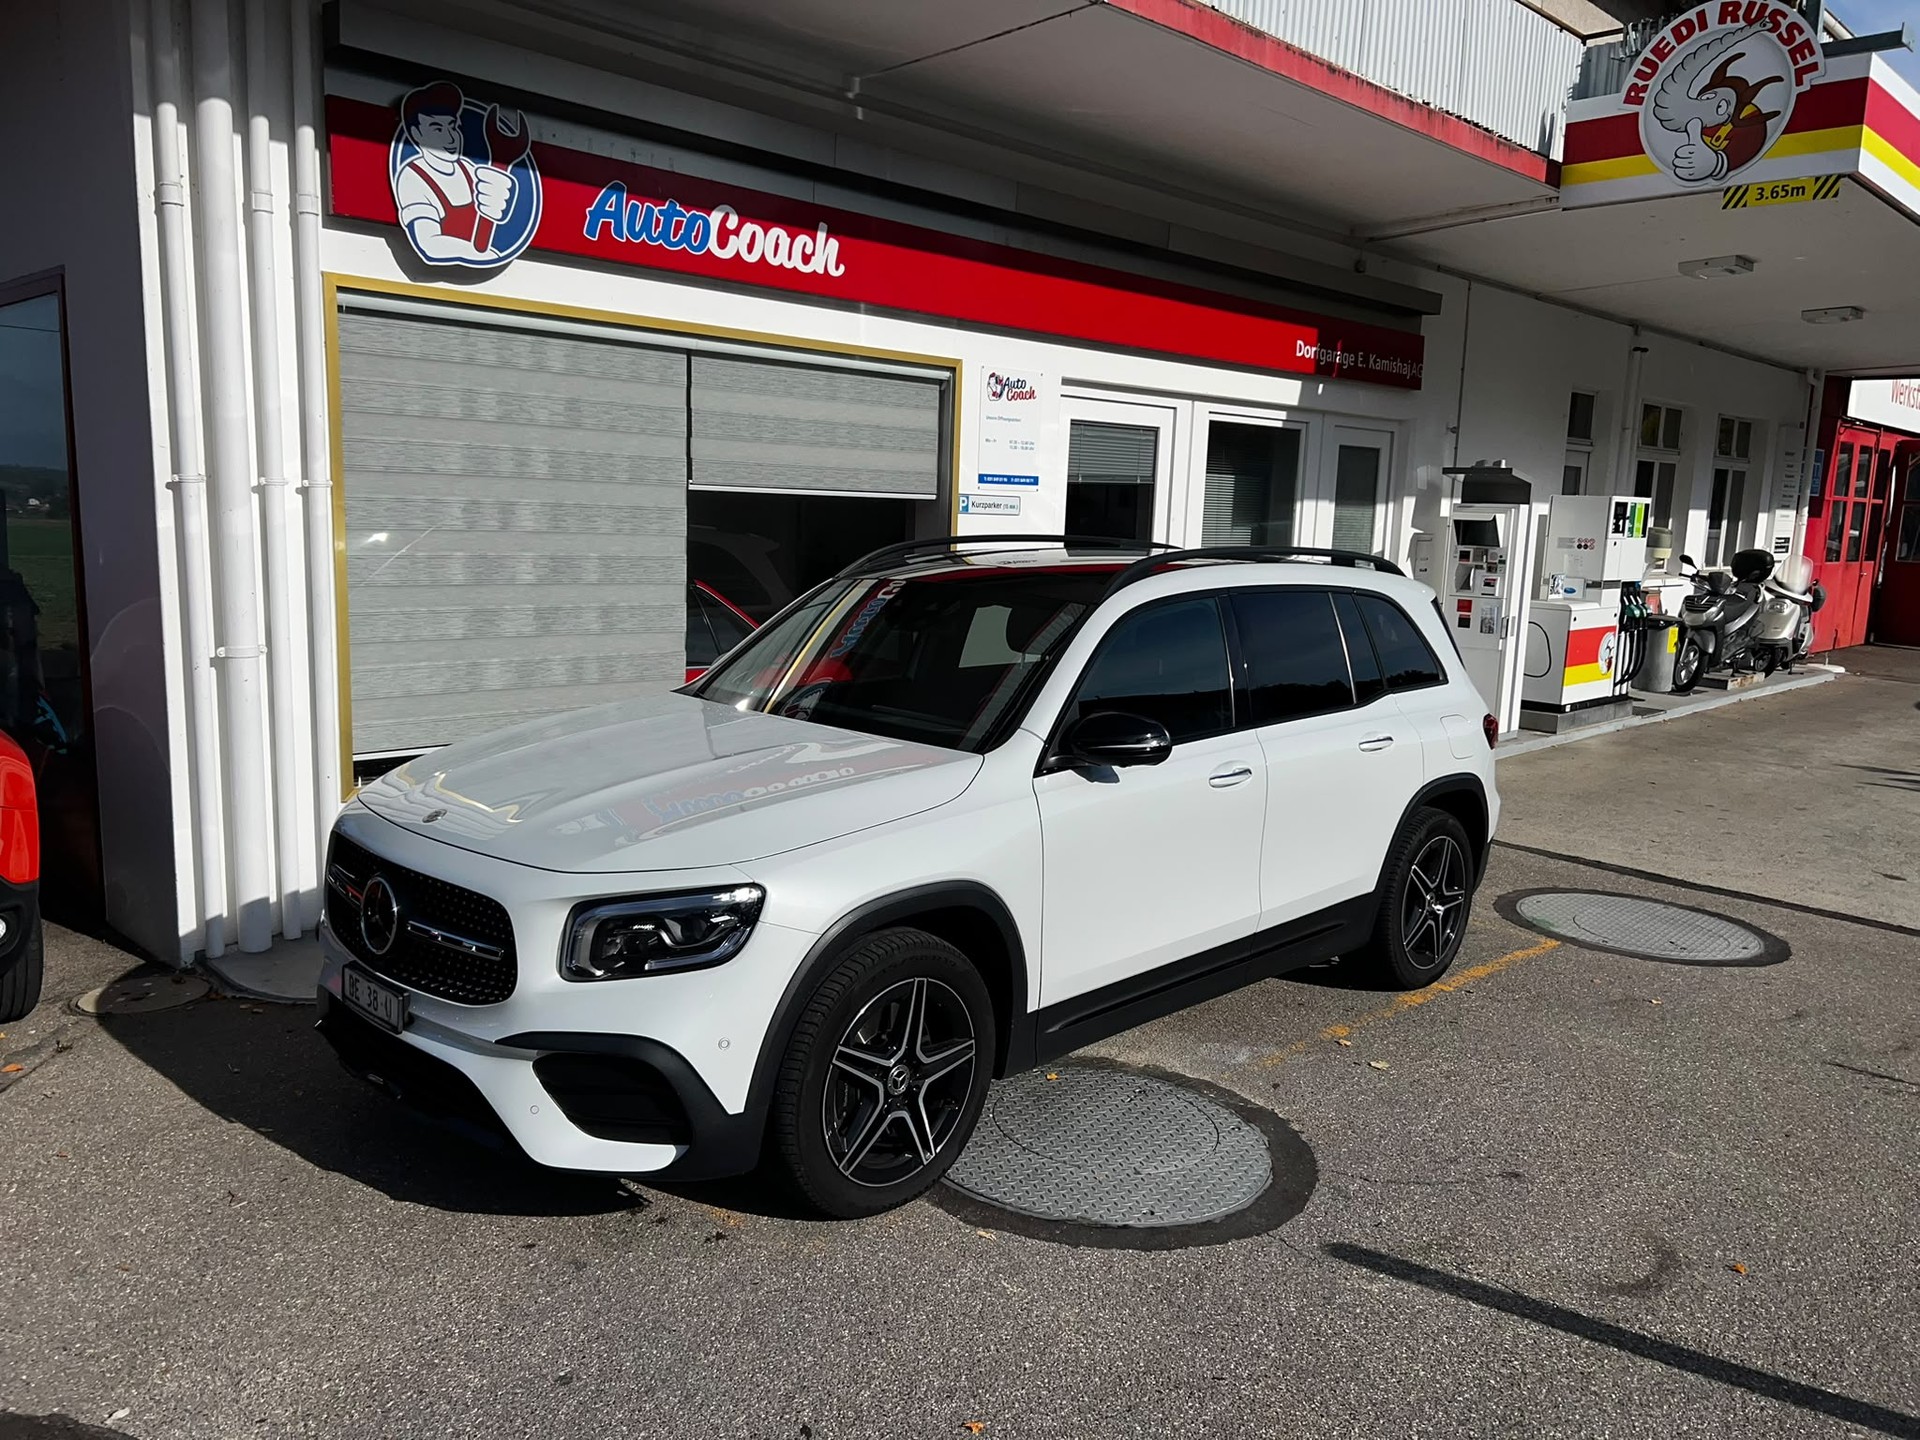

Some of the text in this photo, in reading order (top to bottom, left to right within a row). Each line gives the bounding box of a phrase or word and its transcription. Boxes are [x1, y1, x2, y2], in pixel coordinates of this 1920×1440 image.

[1623, 9, 1708, 106] RUEDI
[1755, 184, 1806, 202] 3.65m
[583, 179, 846, 278] AutoCoach
[1295, 340, 1424, 380] Dorfgarage E. Kamishaj AG
[1002, 376, 1027, 391] Auto
[1006, 386, 1037, 402] Coach
[1891, 379, 1920, 411] Werkst
[971, 500, 1002, 511] Kurzparker
